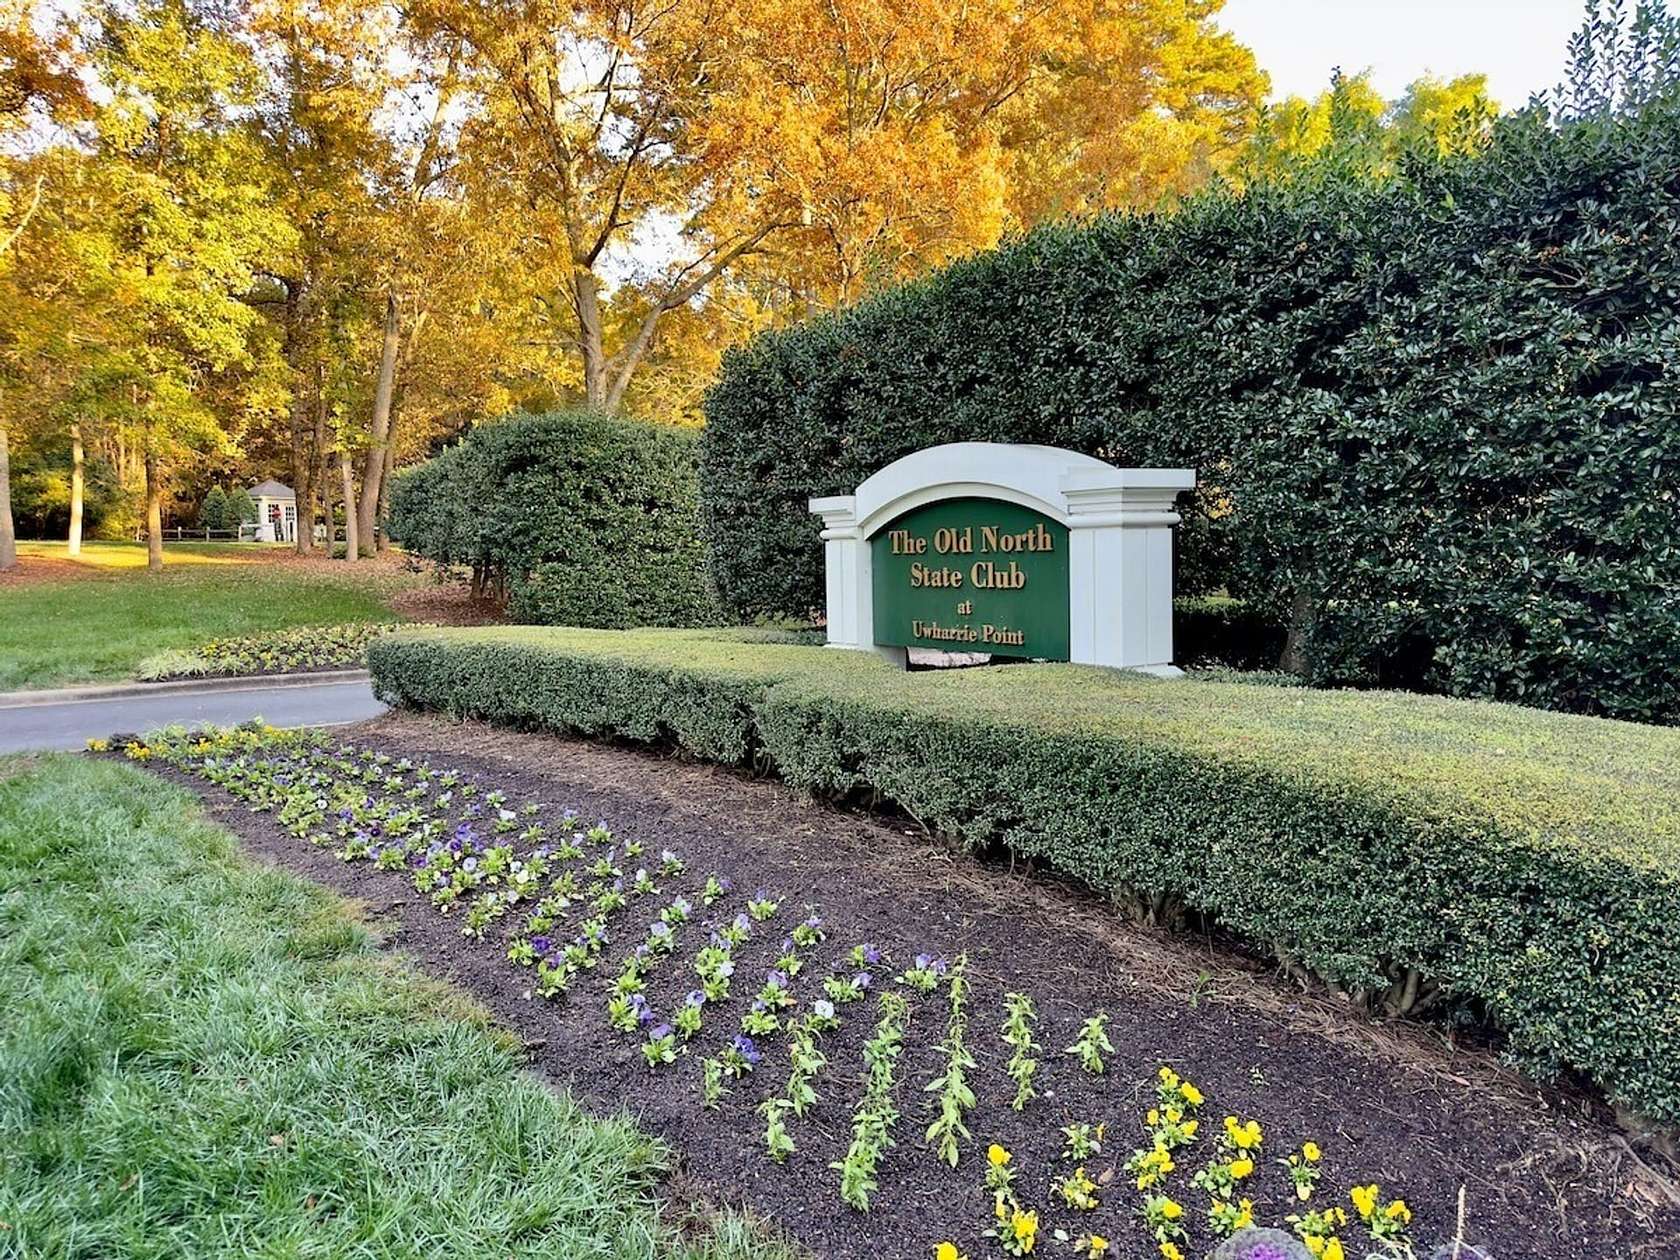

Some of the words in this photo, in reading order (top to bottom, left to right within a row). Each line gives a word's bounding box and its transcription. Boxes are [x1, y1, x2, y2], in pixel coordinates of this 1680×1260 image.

[889, 530, 927, 555] The
[934, 527, 973, 554] Old
[981, 523, 1053, 553] North
[910, 562, 963, 588] State
[970, 561, 1026, 589] Club
[956, 599, 973, 615] at
[912, 620, 978, 643] Uwharrie
[982, 625, 1024, 645] Point
